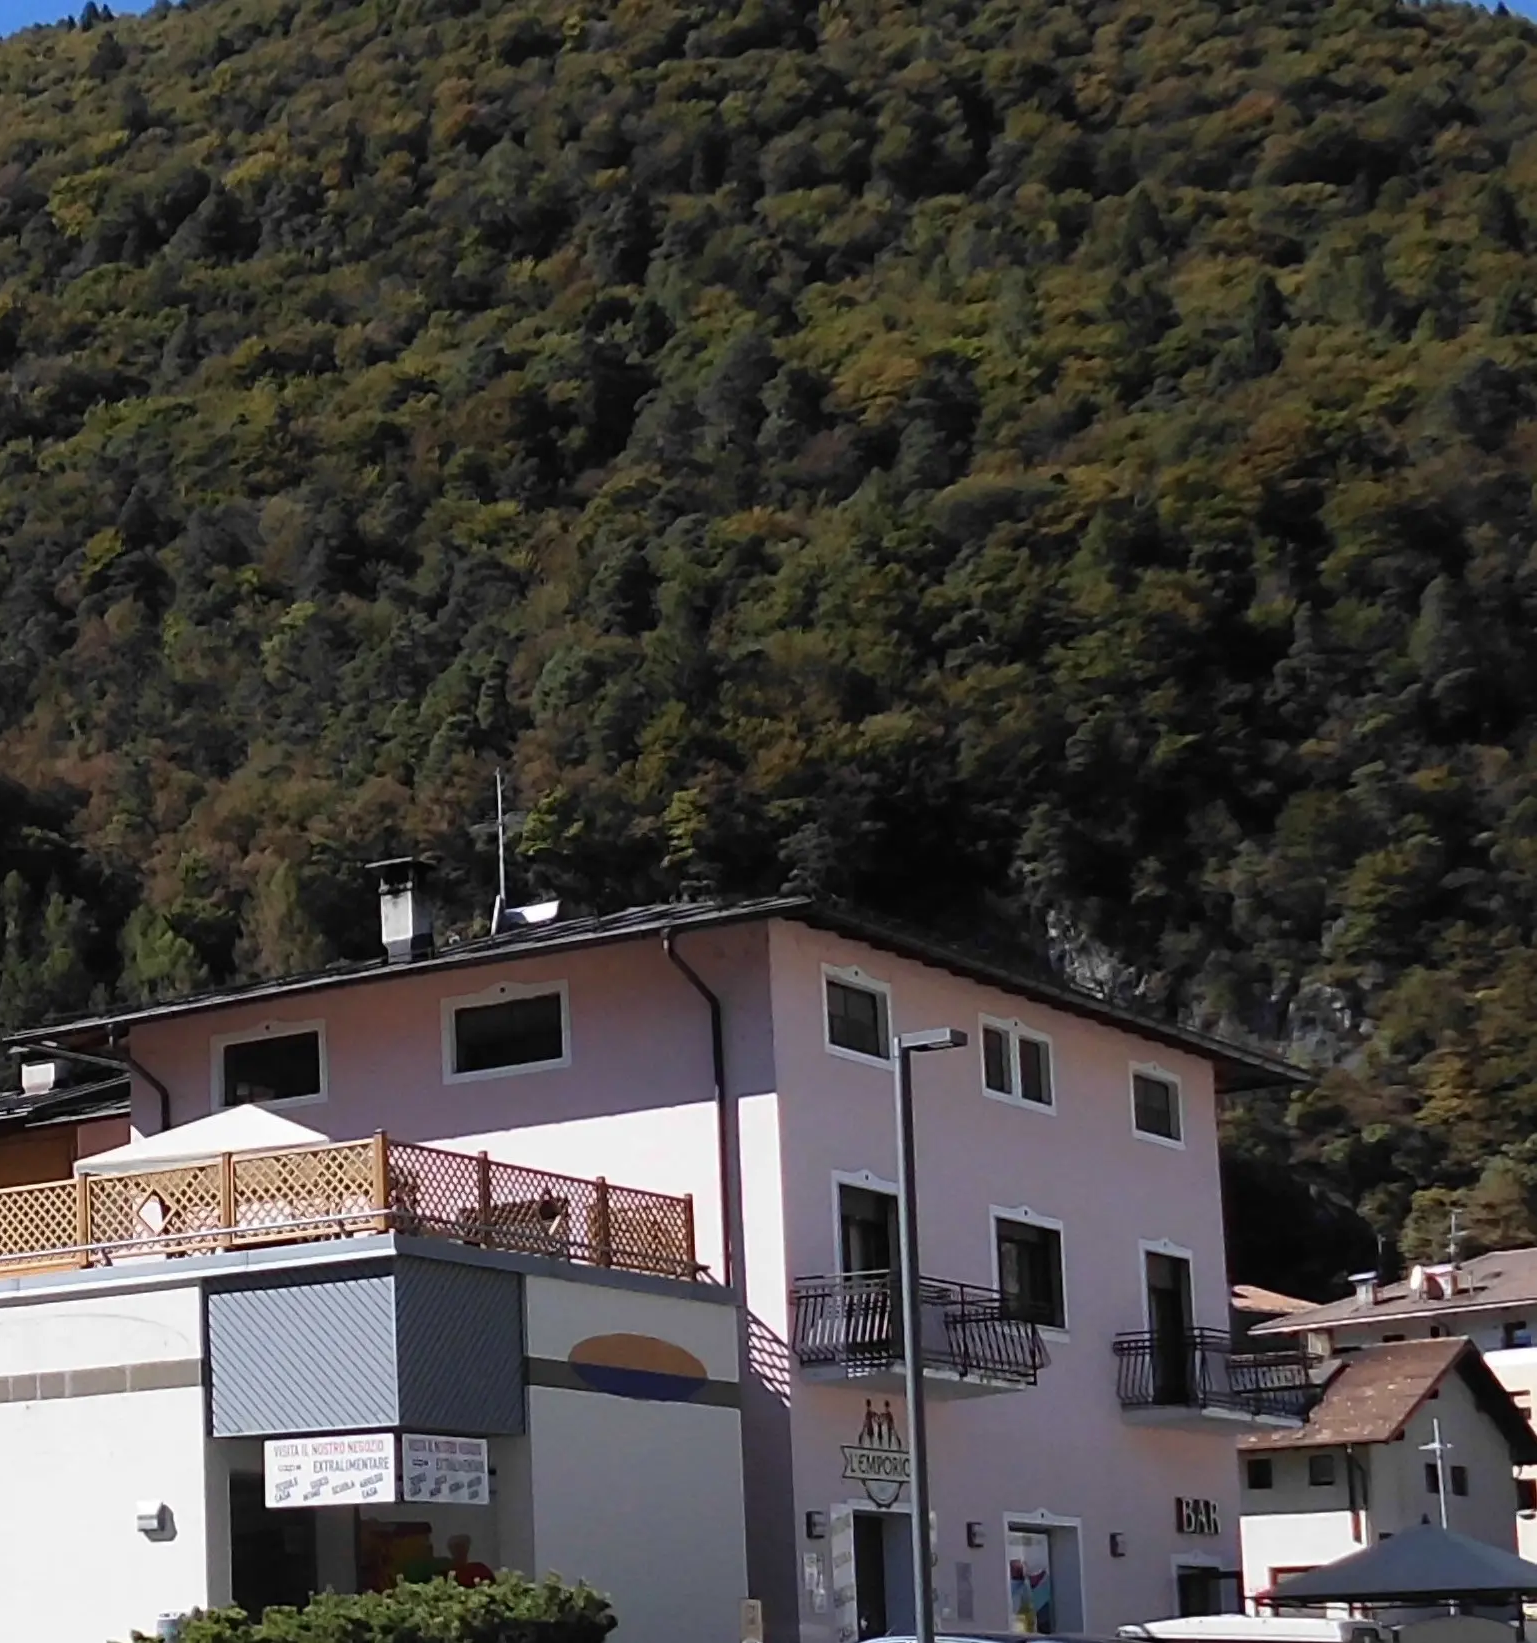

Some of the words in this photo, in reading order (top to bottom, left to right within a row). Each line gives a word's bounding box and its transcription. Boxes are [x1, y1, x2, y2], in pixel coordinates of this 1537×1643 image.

[274, 1444, 300, 1457] VISITA
[301, 1443, 309, 1457] IL
[311, 1441, 345, 1456] NOSTRO
[347, 1439, 384, 1454] NEGOZIO
[1177, 1497, 1221, 1535] BAR
